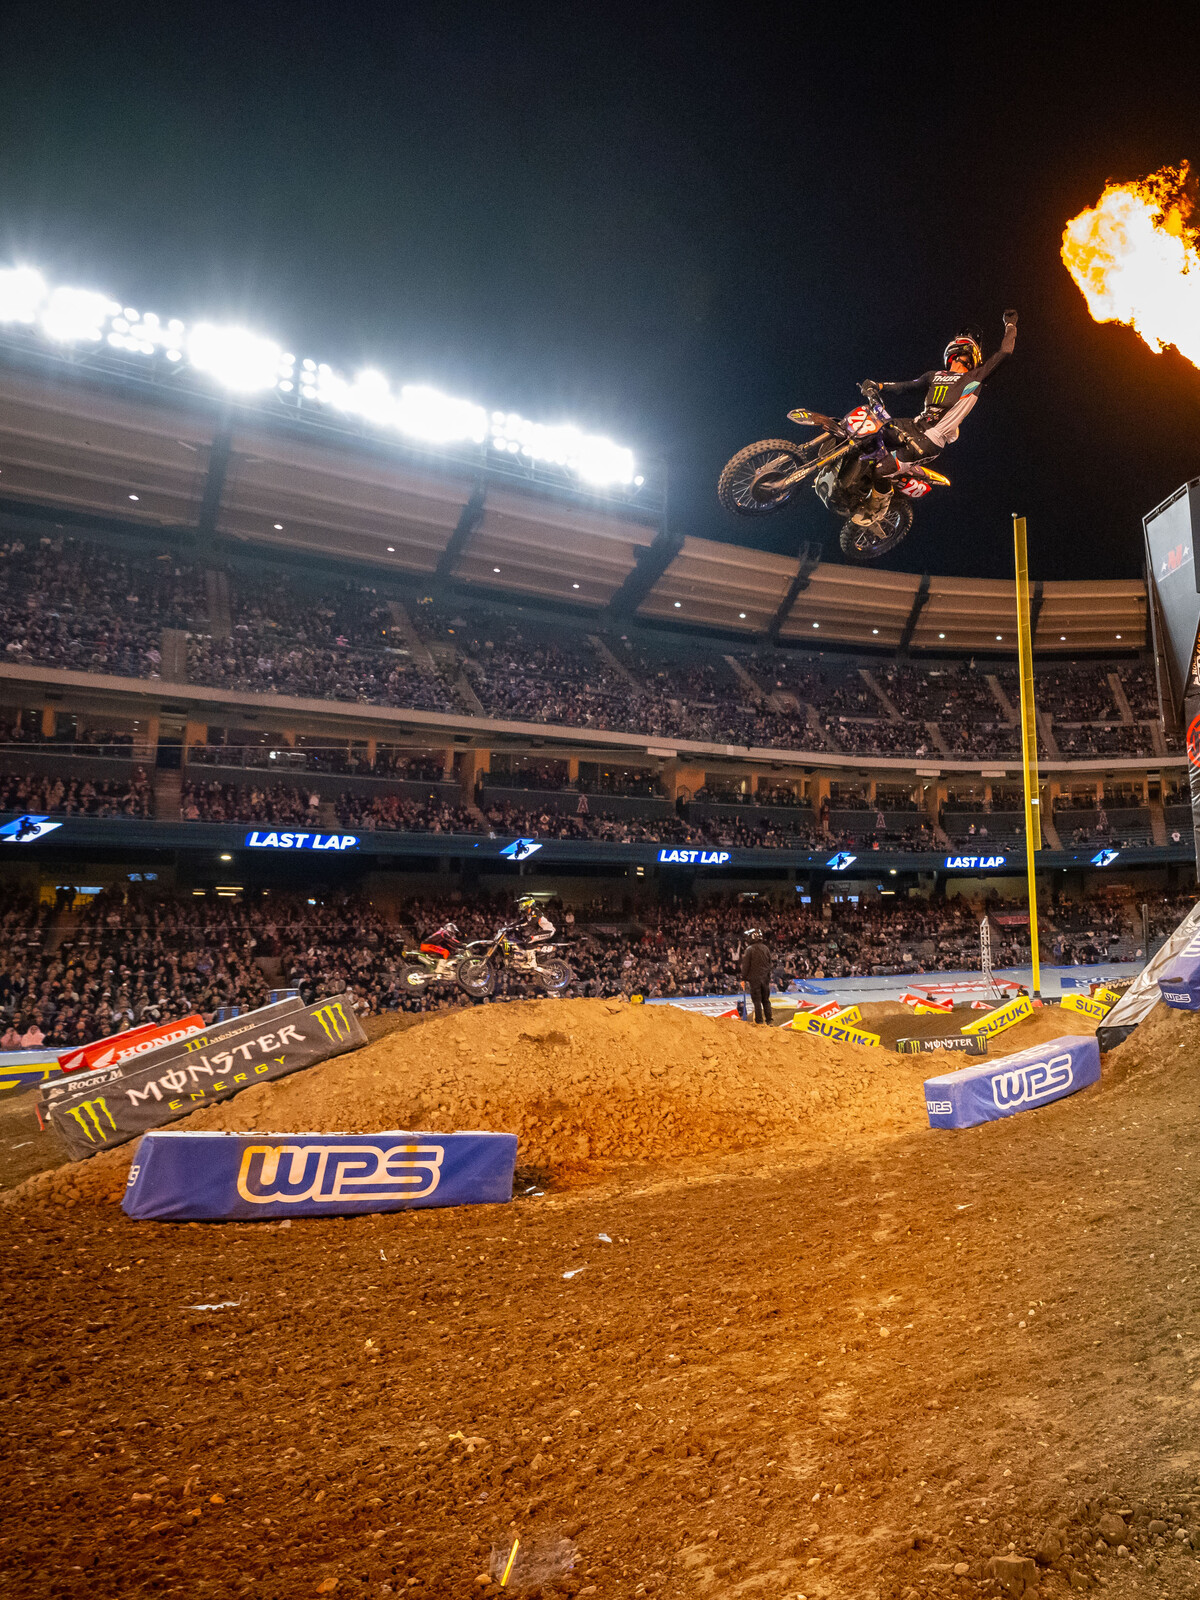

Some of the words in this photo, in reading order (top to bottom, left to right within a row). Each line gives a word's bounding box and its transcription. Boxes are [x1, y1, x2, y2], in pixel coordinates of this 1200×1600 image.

[932, 375, 961, 383] THOR
[848, 411, 876, 435] 28
[902, 479, 927, 498] 28
[249, 832, 308, 849] LAST
[312, 835, 357, 850] LAP
[660, 850, 698, 863] LAST
[701, 851, 729, 864] LAP
[947, 857, 977, 867] LAST
[980, 857, 1004, 867] LAP
[1164, 992, 1191, 1003] WPS
[978, 1002, 1029, 1035] SUZUKI
[116, 1025, 204, 1060] HONDA
[806, 1019, 876, 1047] SUZUKI
[924, 1038, 973, 1050] MONSTER
[125, 1024, 306, 1106] MONSTER
[67, 1075, 106, 1092] ROCKY
[168, 1055, 287, 1110] ENERGY
[991, 1054, 1074, 1110] WPS
[927, 1101, 952, 1114] WPS
[237, 1145, 445, 1204] WPS
